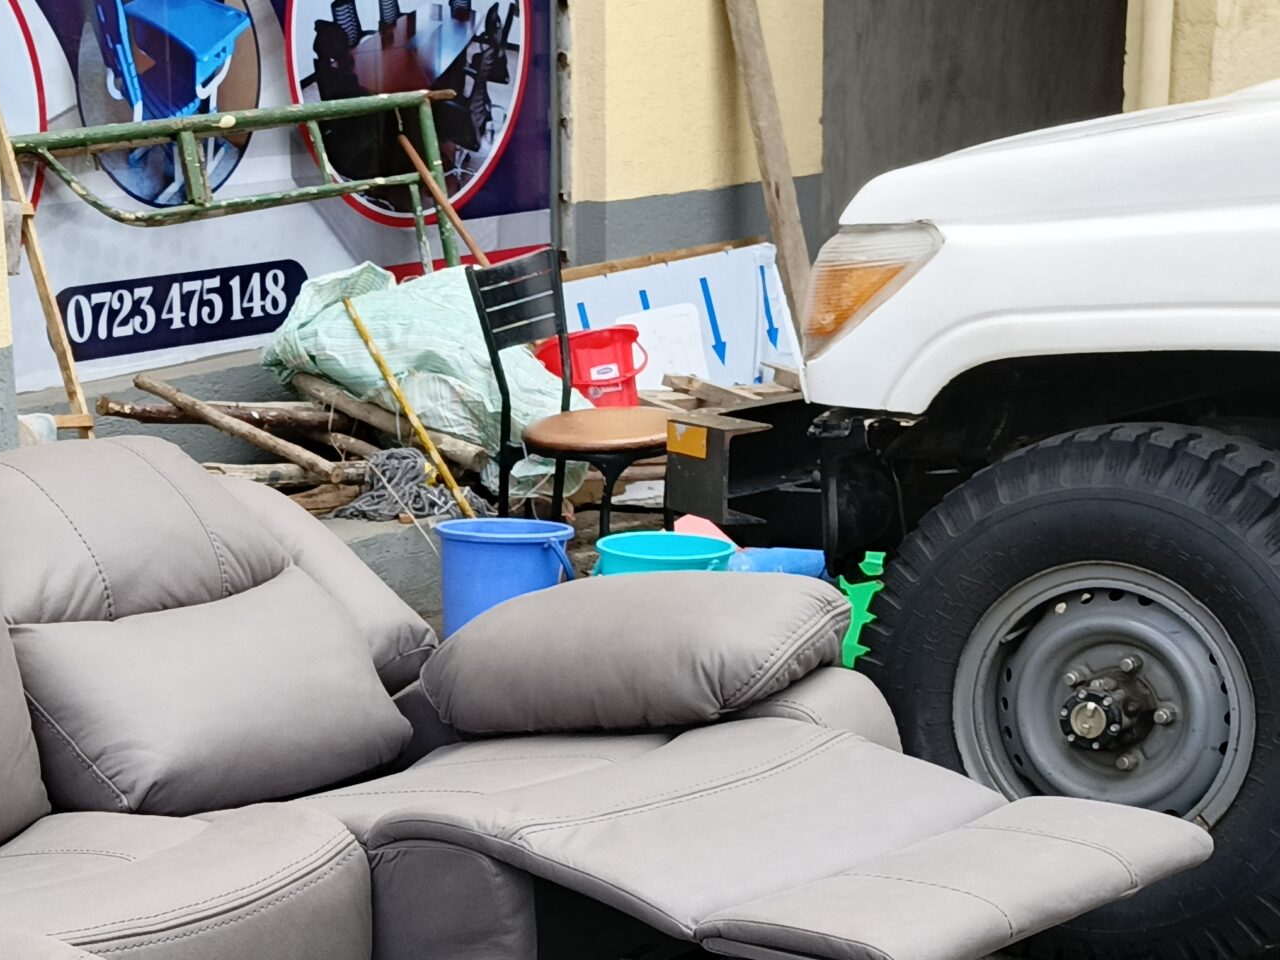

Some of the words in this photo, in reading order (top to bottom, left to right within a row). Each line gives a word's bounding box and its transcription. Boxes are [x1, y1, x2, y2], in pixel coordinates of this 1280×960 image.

[67, 286, 156, 343] 0723
[161, 275, 223, 330] 475
[228, 269, 287, 321] 148
